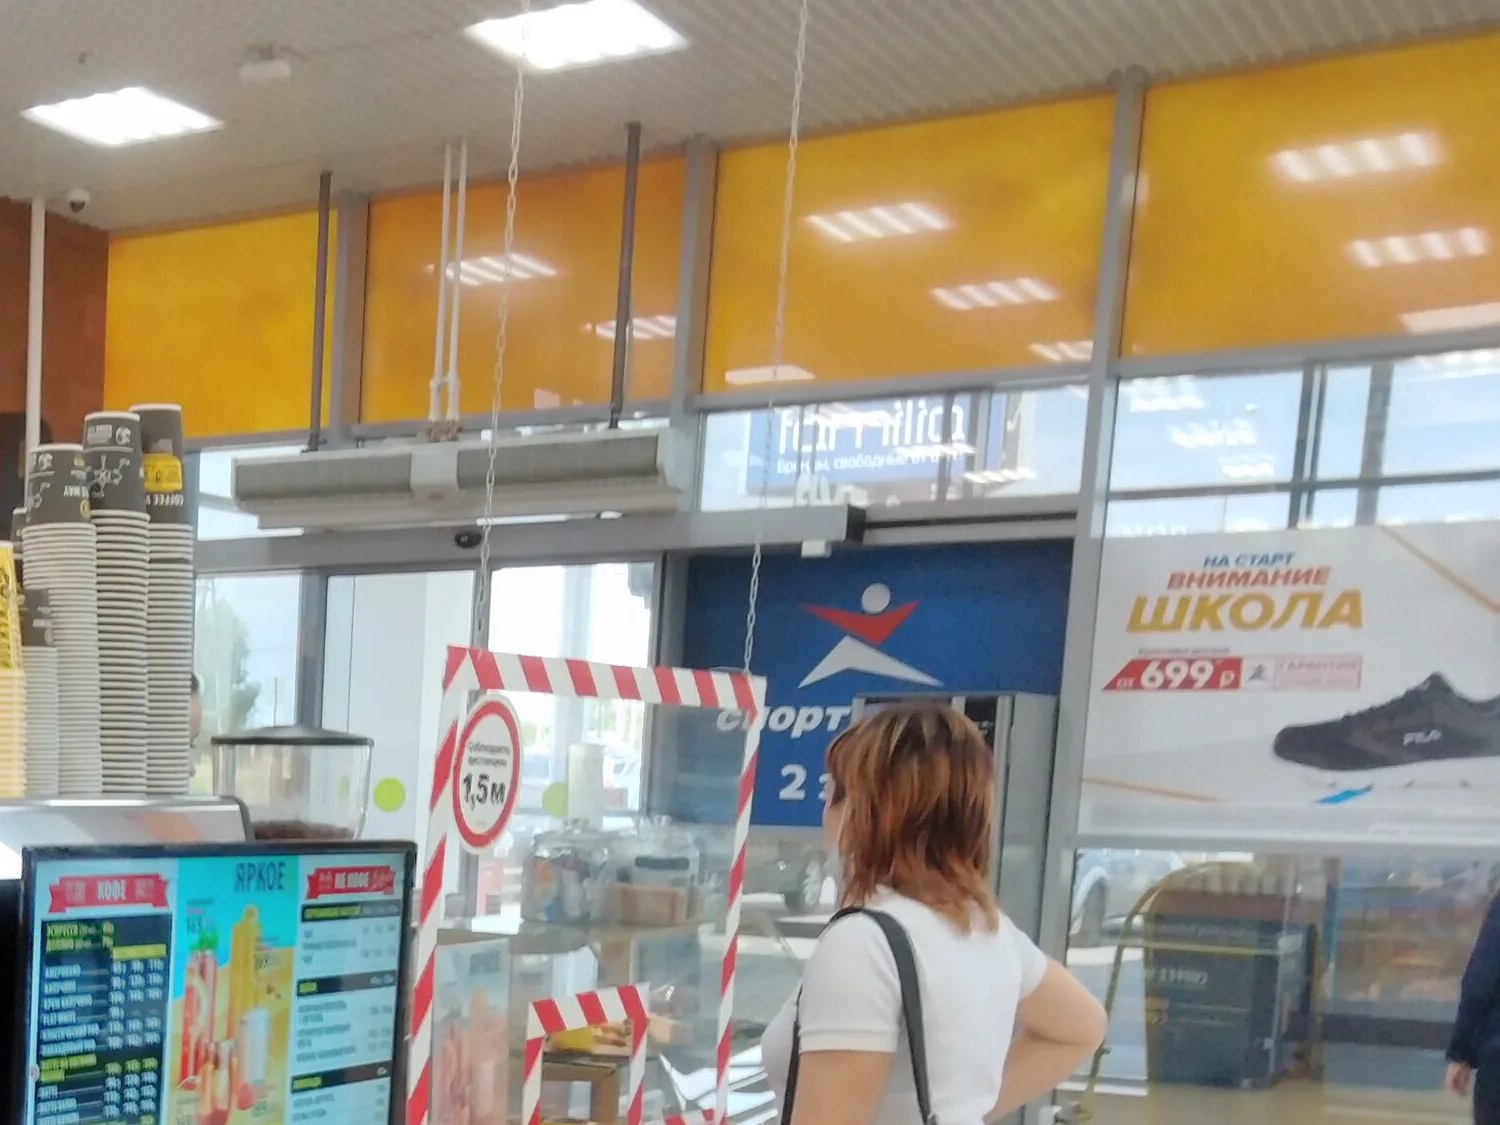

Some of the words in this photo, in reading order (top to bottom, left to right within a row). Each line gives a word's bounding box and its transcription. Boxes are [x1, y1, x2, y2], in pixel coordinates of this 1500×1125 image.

[1204, 555, 1229, 568] НА
[1235, 552, 1296, 566] СТАРТ
[1167, 566, 1332, 590] ВНИМАНИЕ
[1126, 588, 1364, 633] ШКОЛА
[1140, 660, 1215, 690] 699
[779, 764, 806, 801] 2
[97, 879, 128, 901] КОФЕ
[234, 861, 286, 892] ЯРКОЕ
